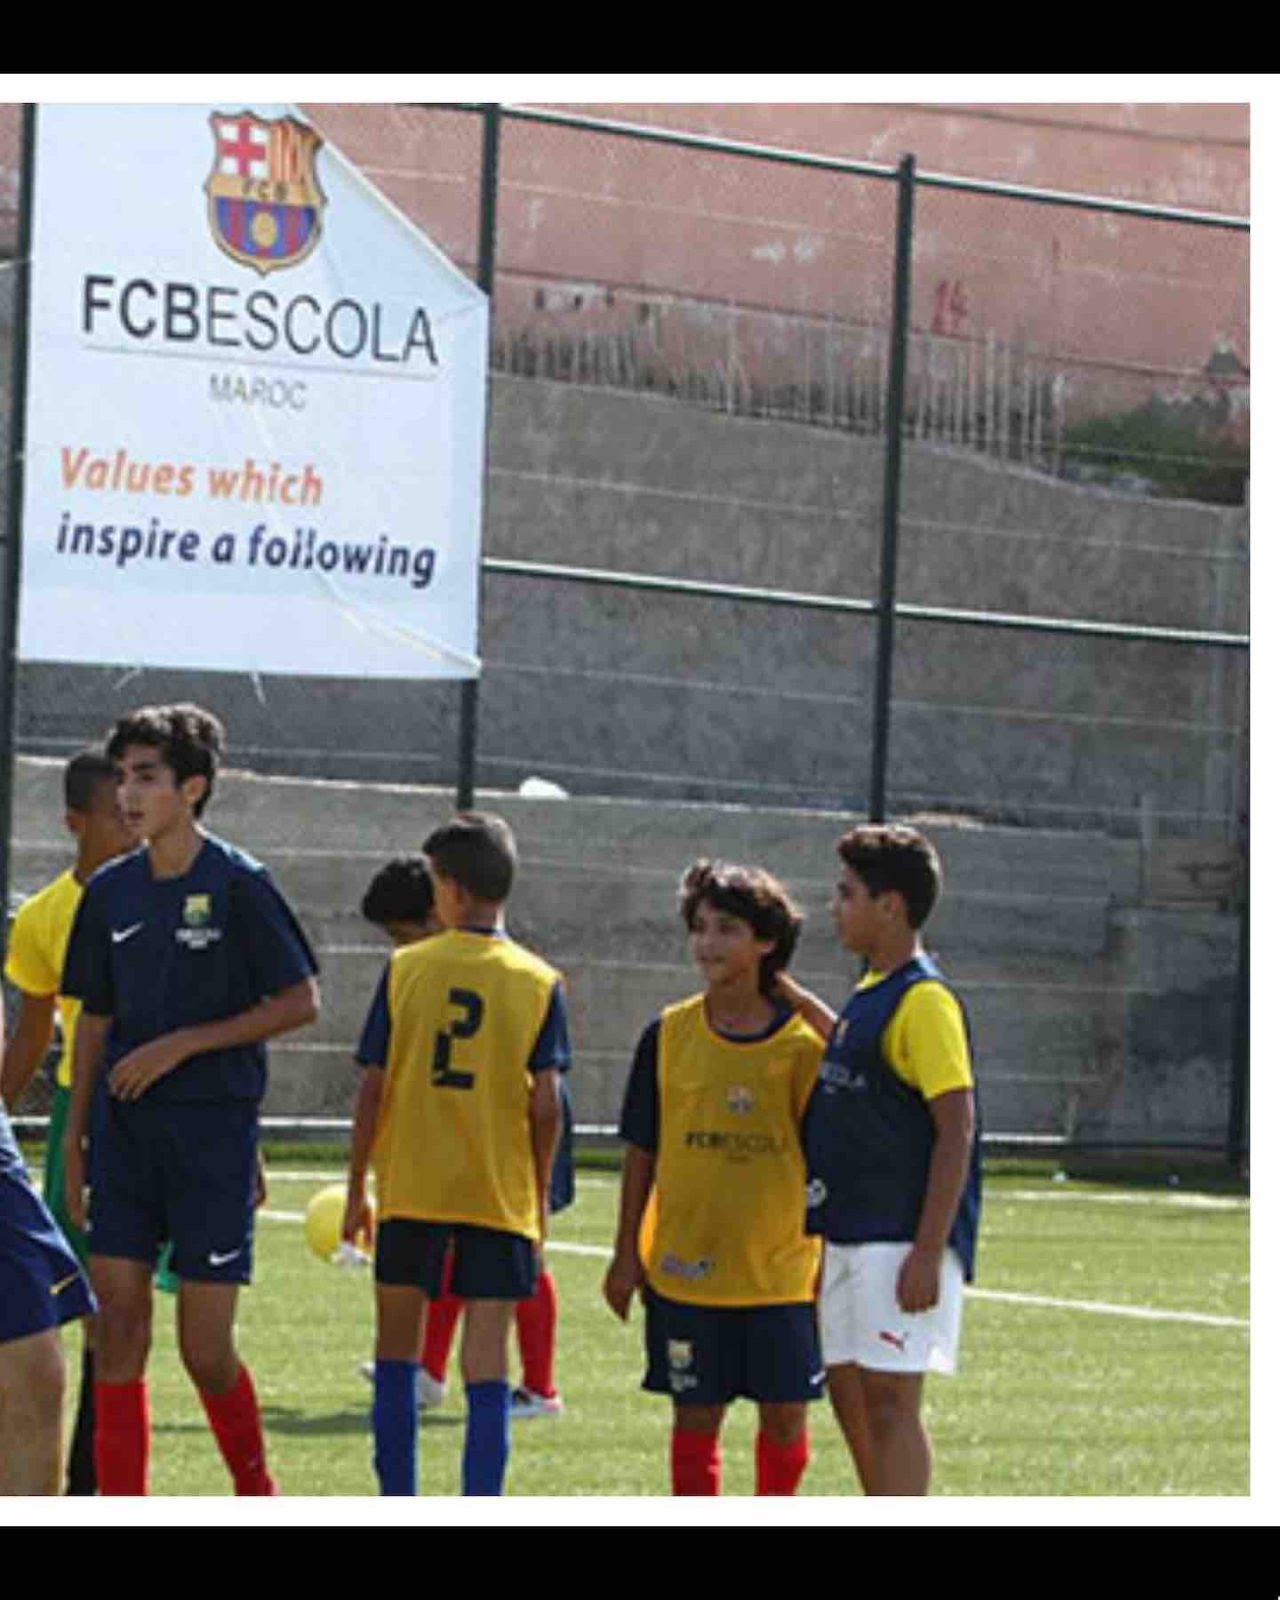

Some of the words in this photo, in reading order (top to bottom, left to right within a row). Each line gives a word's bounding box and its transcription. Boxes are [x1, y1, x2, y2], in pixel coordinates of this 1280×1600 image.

[82, 274, 439, 365] FCBESCOLA
[209, 374, 307, 410] MAROC
[60, 446, 193, 496] Values
[208, 459, 323, 506] which
[56, 512, 199, 567] inspire
[211, 532, 236, 562] a
[432, 986, 484, 1090] 2
